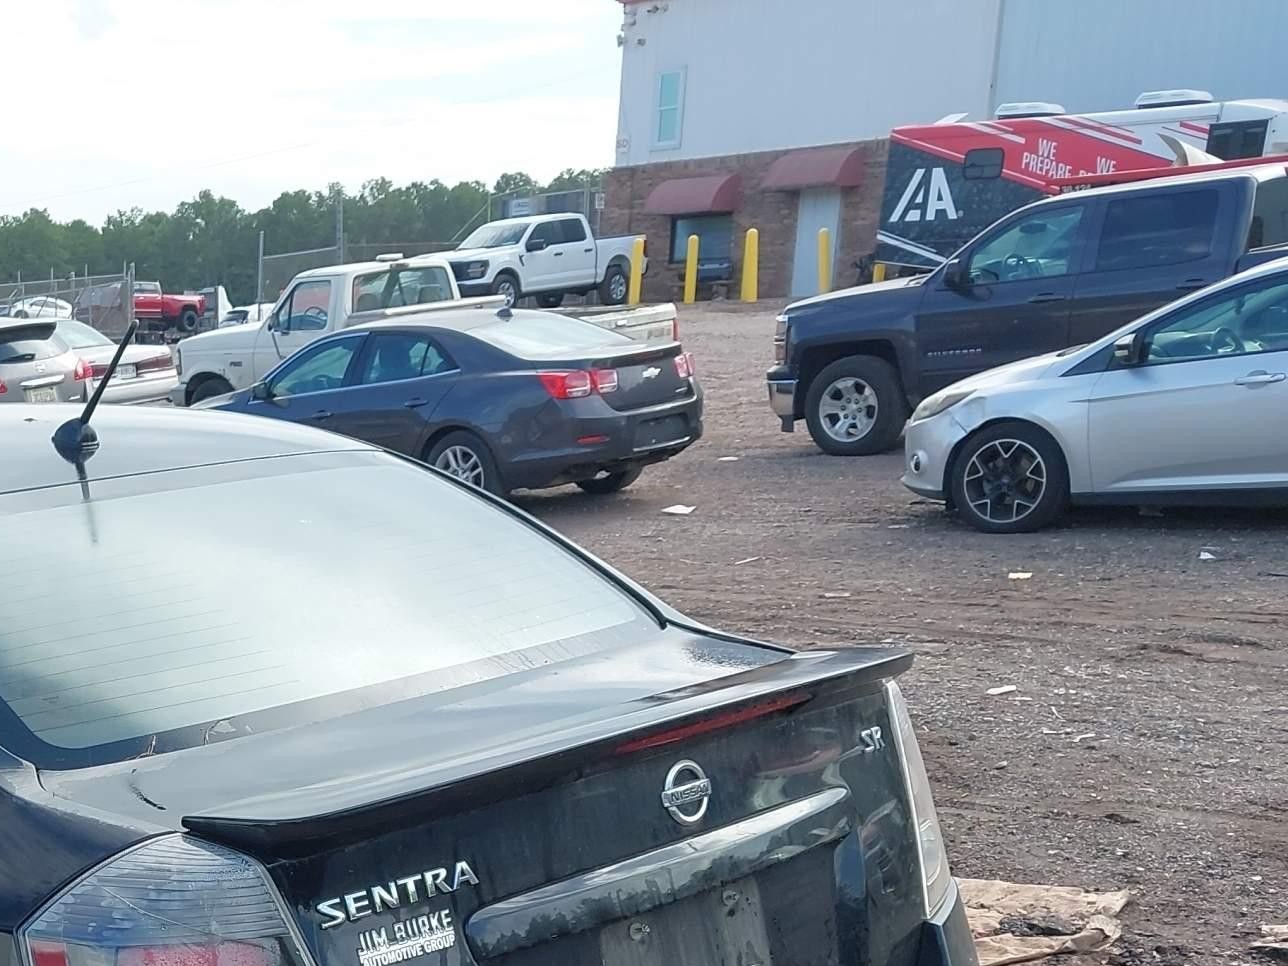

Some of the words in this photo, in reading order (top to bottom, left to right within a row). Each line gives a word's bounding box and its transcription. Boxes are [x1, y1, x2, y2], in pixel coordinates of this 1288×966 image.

[1038, 138, 1058, 160] WE
[1021, 151, 1073, 179] PREPARE
[861, 726, 885, 753] SR
[670, 782, 710, 804] NISSAN
[316, 860, 480, 930] SENTRA
[392, 908, 455, 946] BURKE
[424, 934, 456, 955] GROUP
